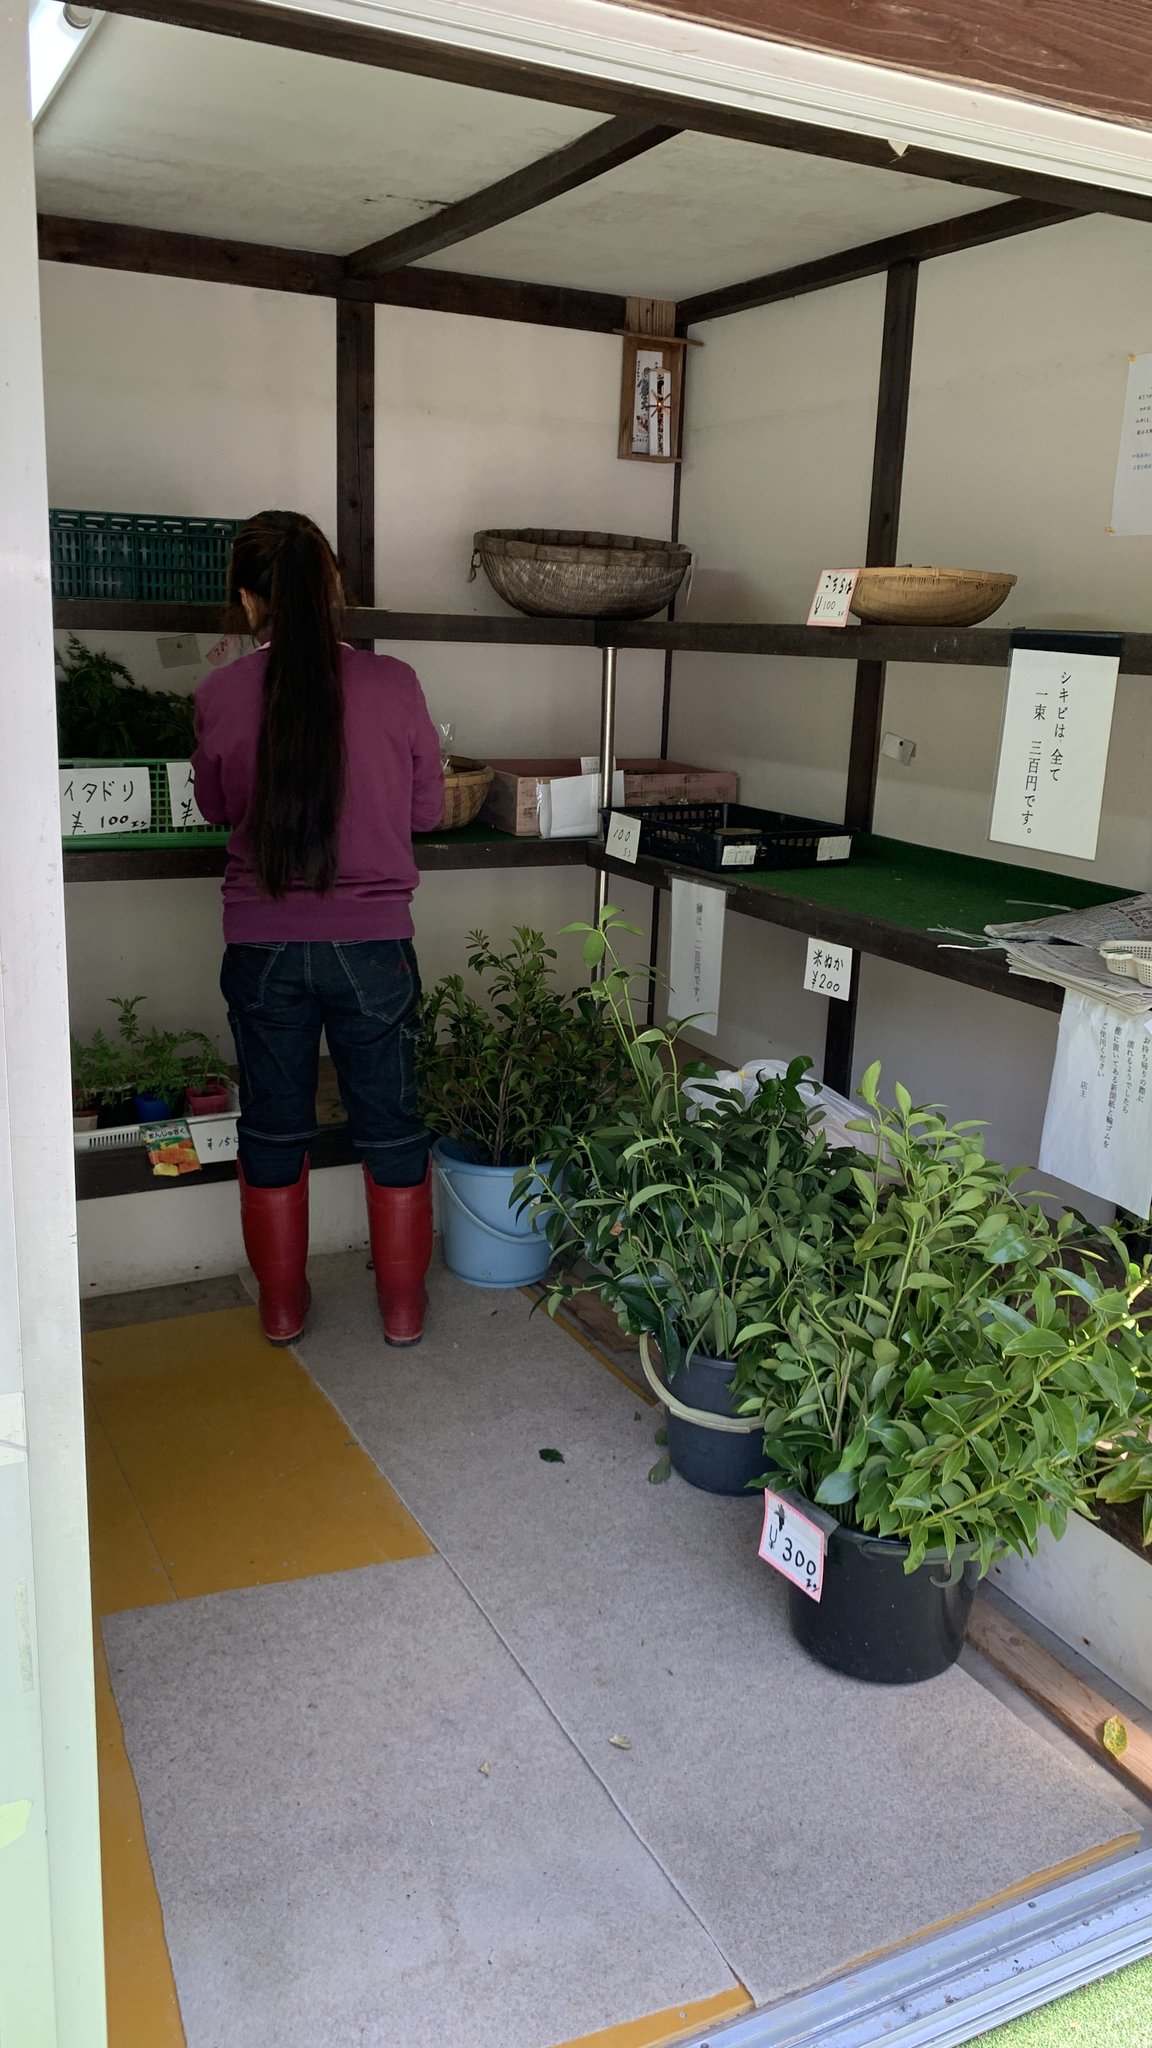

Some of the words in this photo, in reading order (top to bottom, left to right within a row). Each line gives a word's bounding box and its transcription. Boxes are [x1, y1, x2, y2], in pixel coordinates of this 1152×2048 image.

[1033, 692, 1048, 721] 一束
[64, 781, 134, 803] イタドリ
[1021, 741, 1042, 834] 三百円です。
[613, 829, 631, 842] 100
[813, 949, 844, 971] 米ぬか
[812, 970, 840, 992] ¥200
[769, 1524, 816, 1575] ¥300
